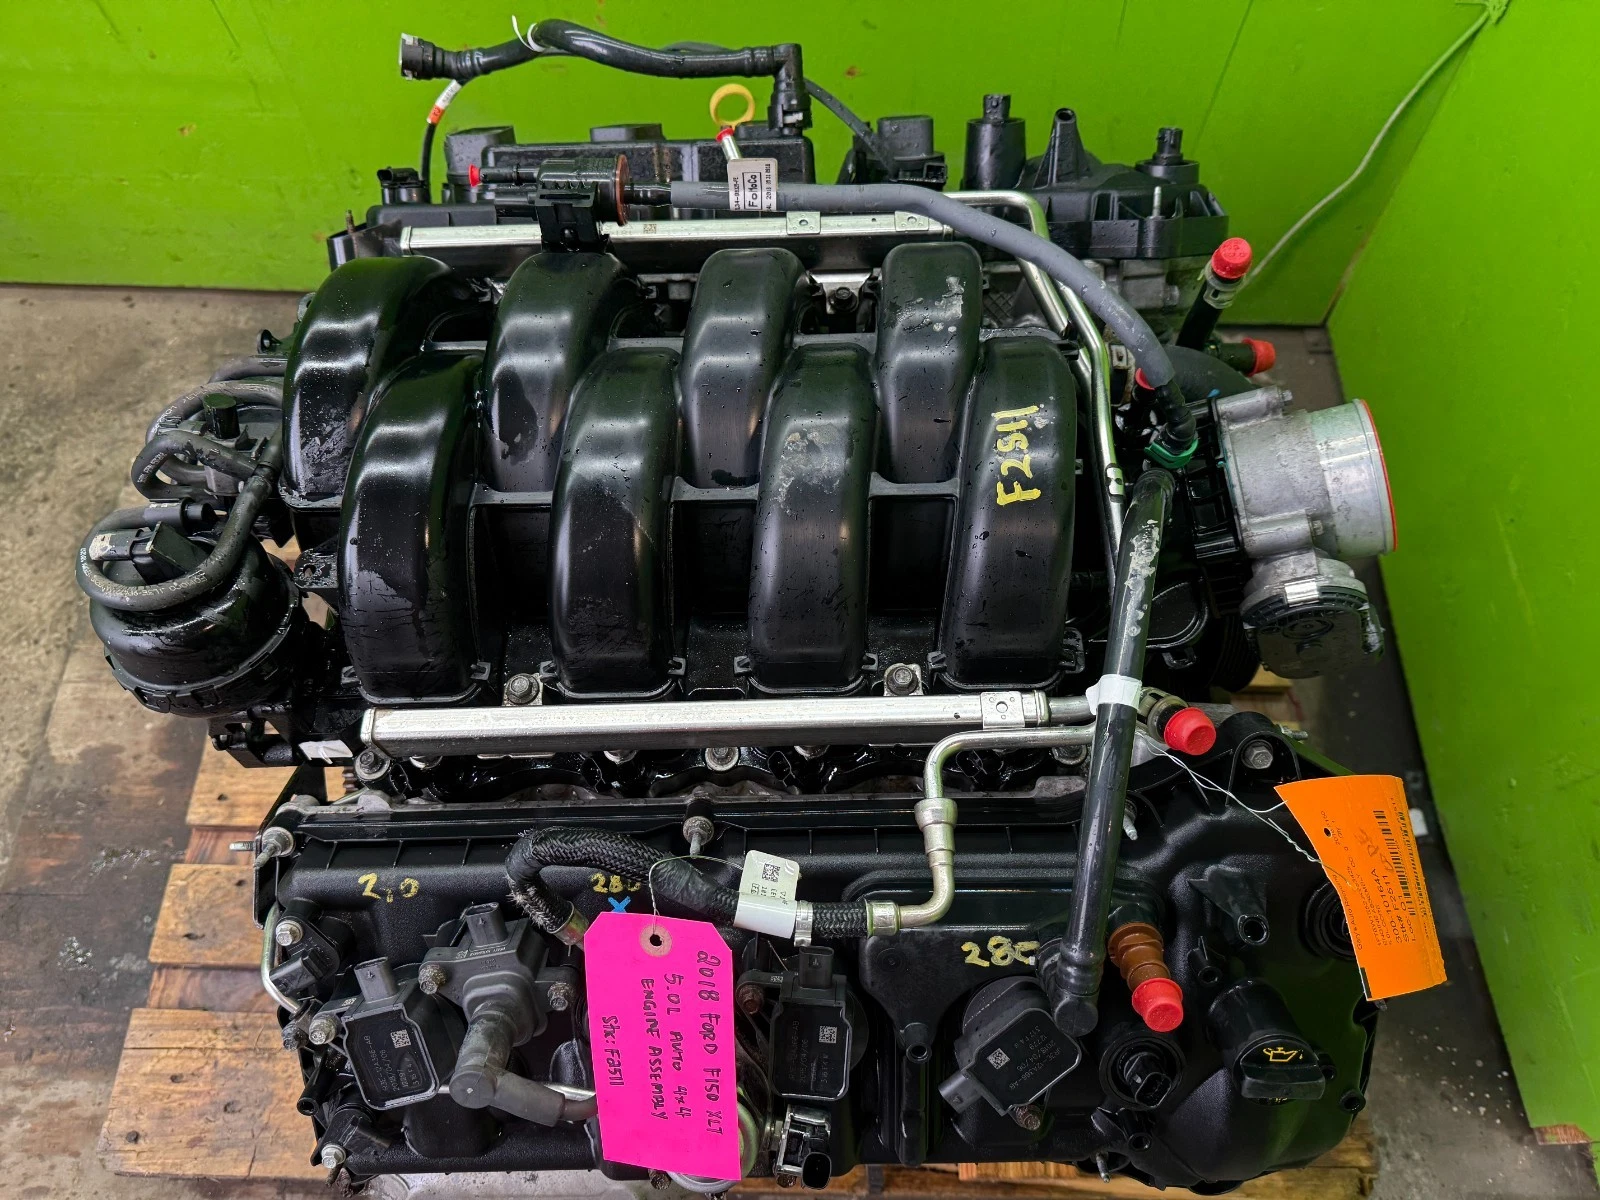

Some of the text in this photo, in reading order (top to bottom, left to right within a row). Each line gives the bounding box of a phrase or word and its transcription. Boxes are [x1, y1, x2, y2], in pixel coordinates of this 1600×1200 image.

[747, 174, 759, 208] FoMoCo
[993, 405, 1042, 507] F2511
[664, 973, 685, 1015] 5.0L
[641, 978, 669, 1120] ENGINE ASSEMBLY
[669, 1031, 684, 1072] AUTO
[697, 950, 724, 1136] 2018 FORD F150 XLT
